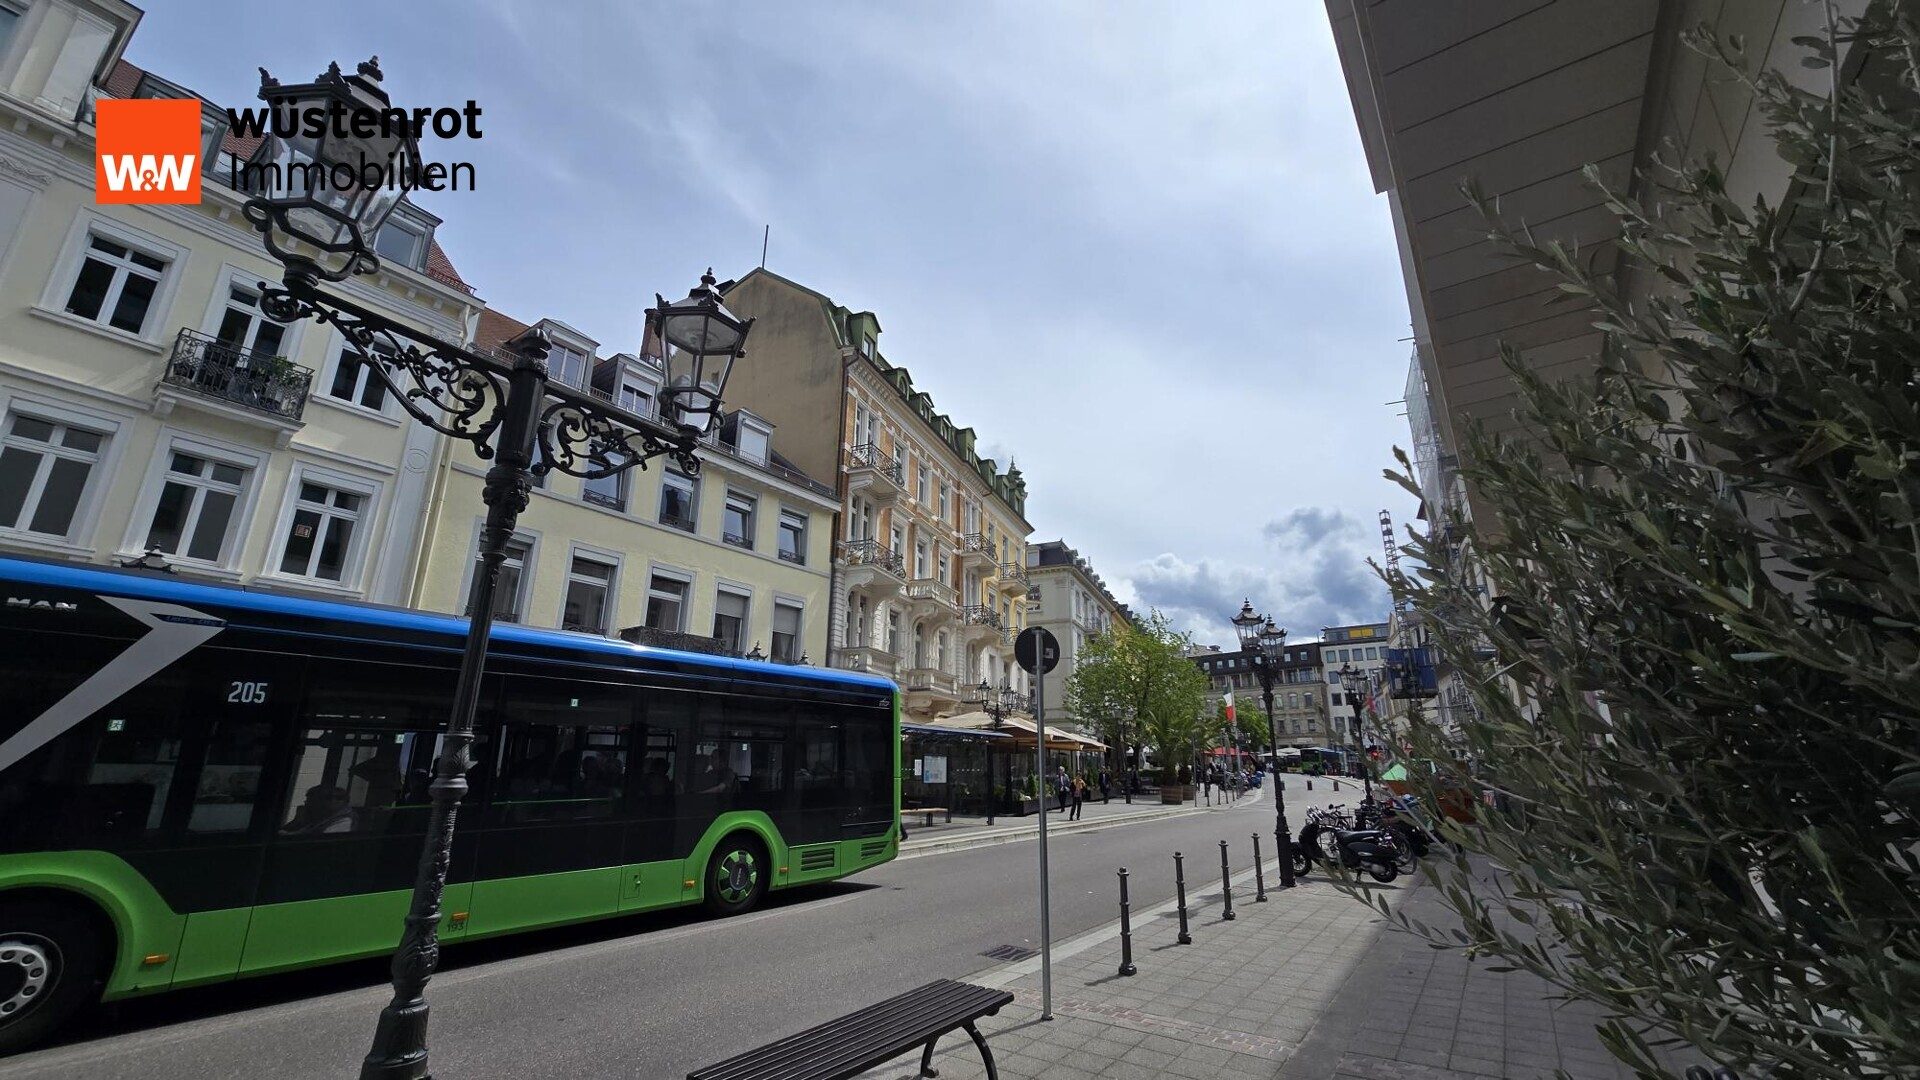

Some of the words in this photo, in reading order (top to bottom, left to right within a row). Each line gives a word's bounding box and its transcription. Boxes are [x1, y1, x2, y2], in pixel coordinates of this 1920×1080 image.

[6, 597, 78, 610] MAN
[227, 681, 269, 704] 205
[446, 921, 464, 933] 193
